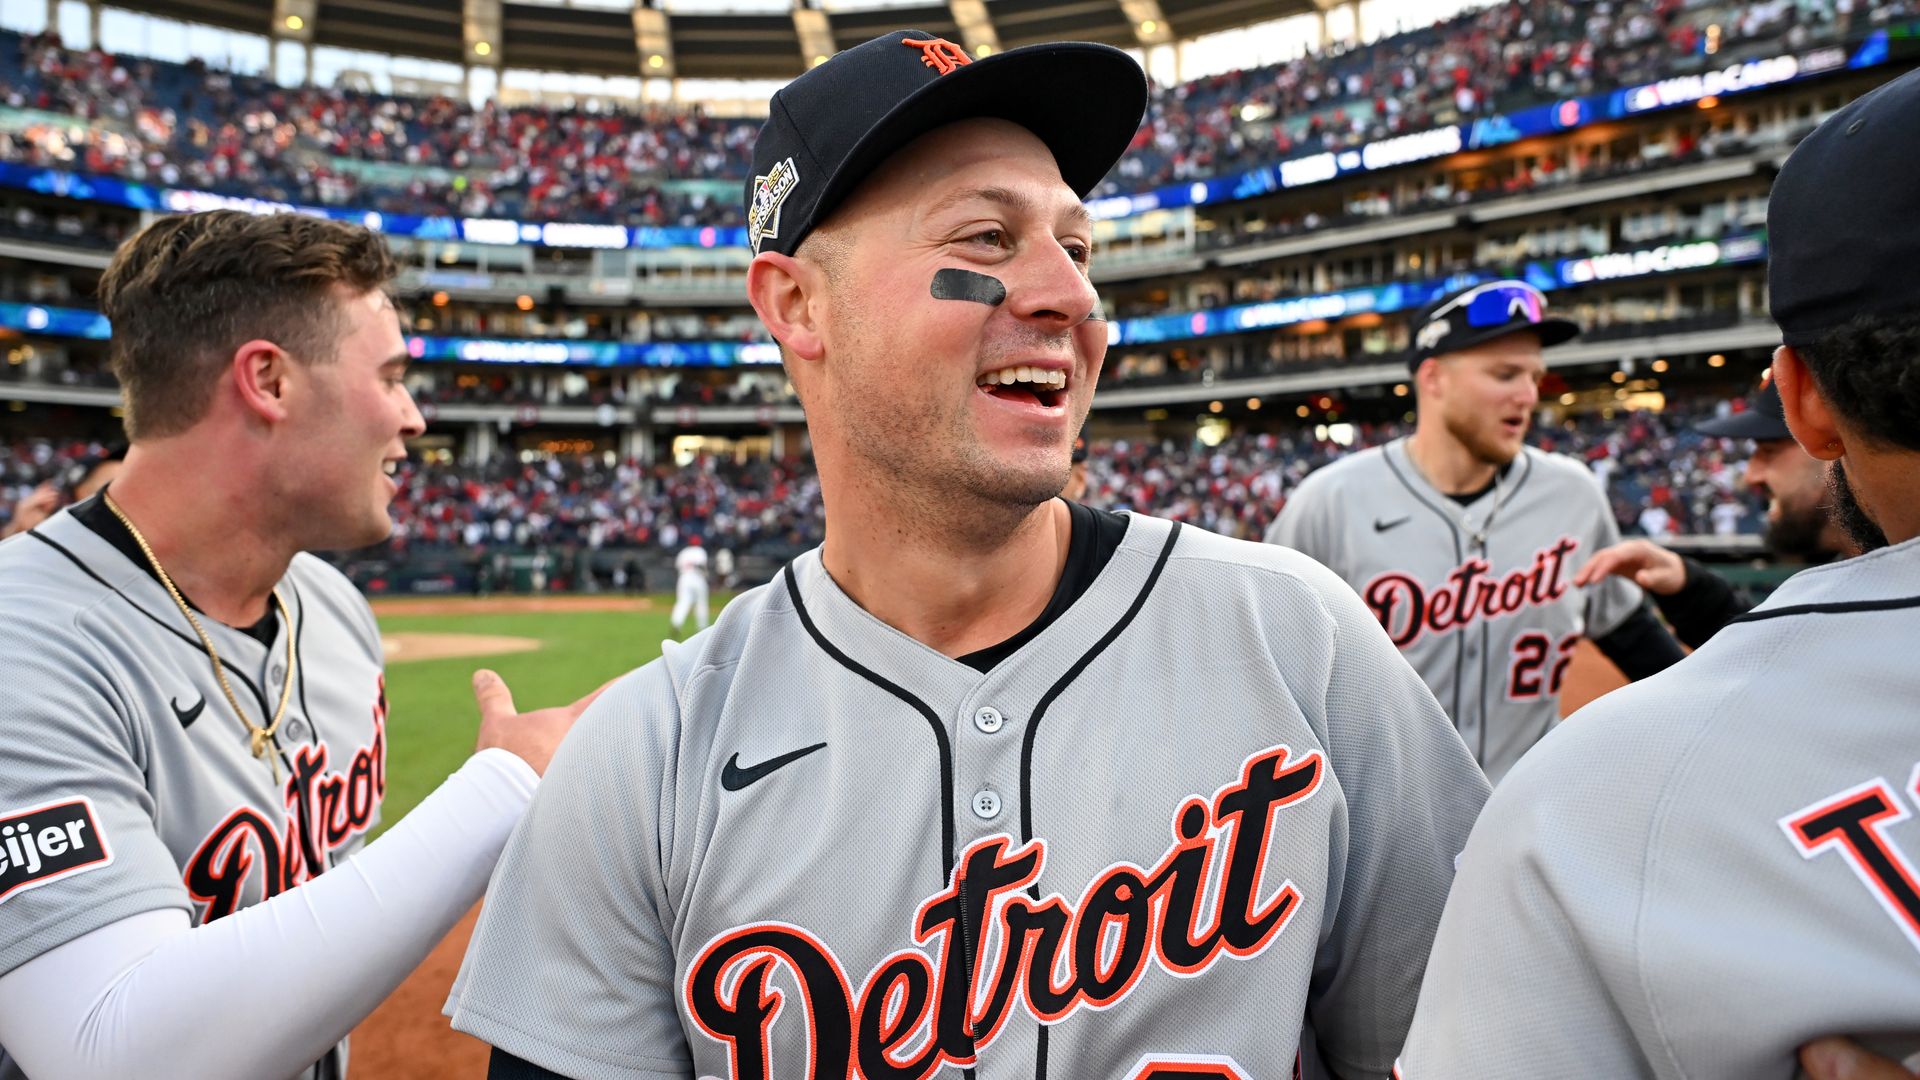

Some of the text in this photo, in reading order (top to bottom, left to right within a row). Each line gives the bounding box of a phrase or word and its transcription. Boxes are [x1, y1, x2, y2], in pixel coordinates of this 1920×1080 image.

[1362, 533, 1580, 651] Detroit
[0, 818, 86, 876] ijer
[682, 744, 1326, 1080] Detroit
